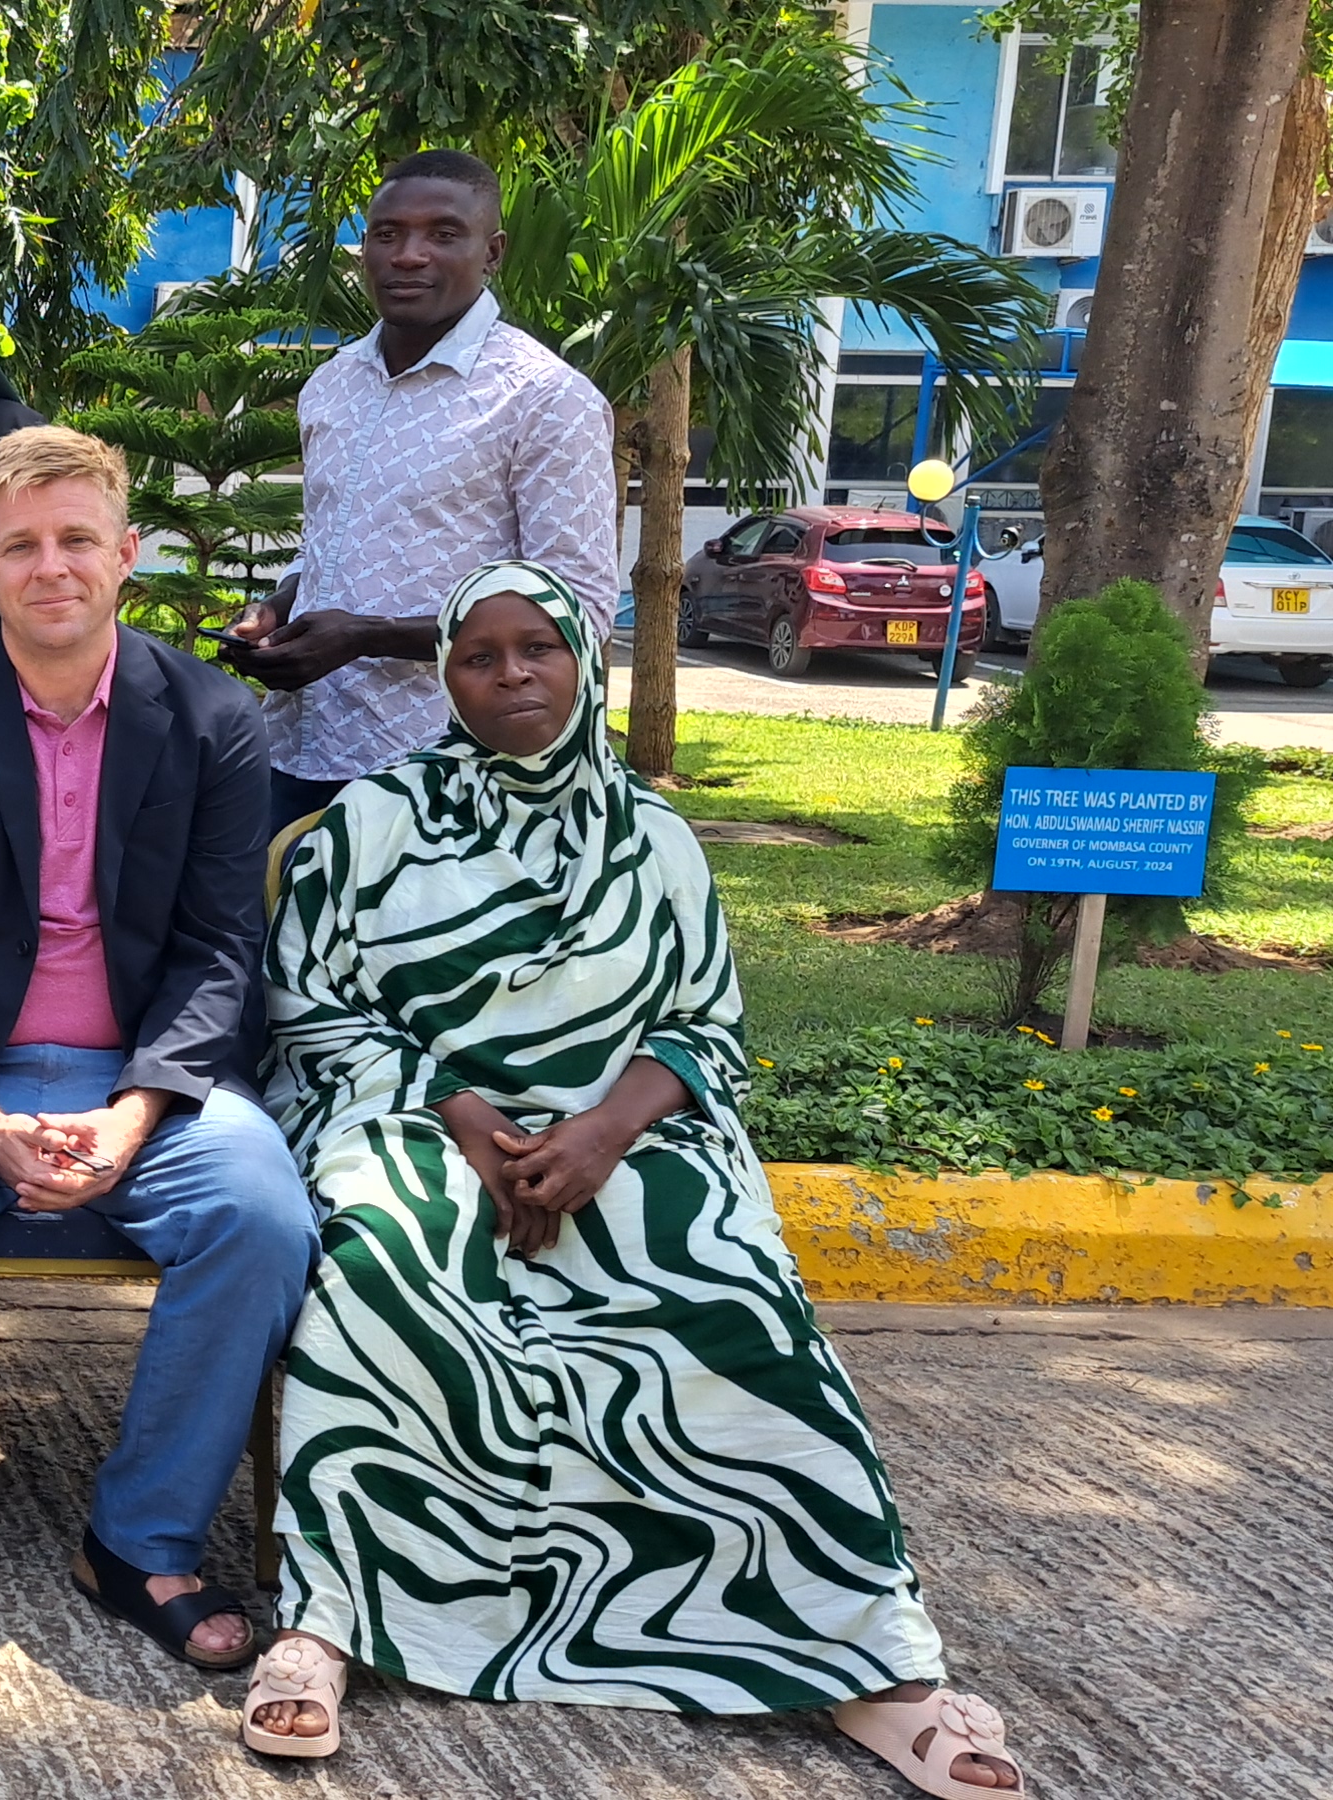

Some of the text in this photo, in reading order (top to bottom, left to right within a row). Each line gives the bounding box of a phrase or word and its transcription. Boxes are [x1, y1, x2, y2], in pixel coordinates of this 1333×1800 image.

[1277, 590, 1299, 601] KCY
[894, 621, 914, 632] KDP
[889, 632, 914, 643] 229A
[1010, 788, 1208, 812] THIS TREE WAS PLANTED BY
[1004, 813, 1205, 835] HON. ABDULSWAMAD SHERIFF NASSIR
[1012, 837, 1194, 854] GOVERNER OF MOMBASA COUNTY
[1027, 856, 1173, 872] ON 19TH, AUGUST, 2024
